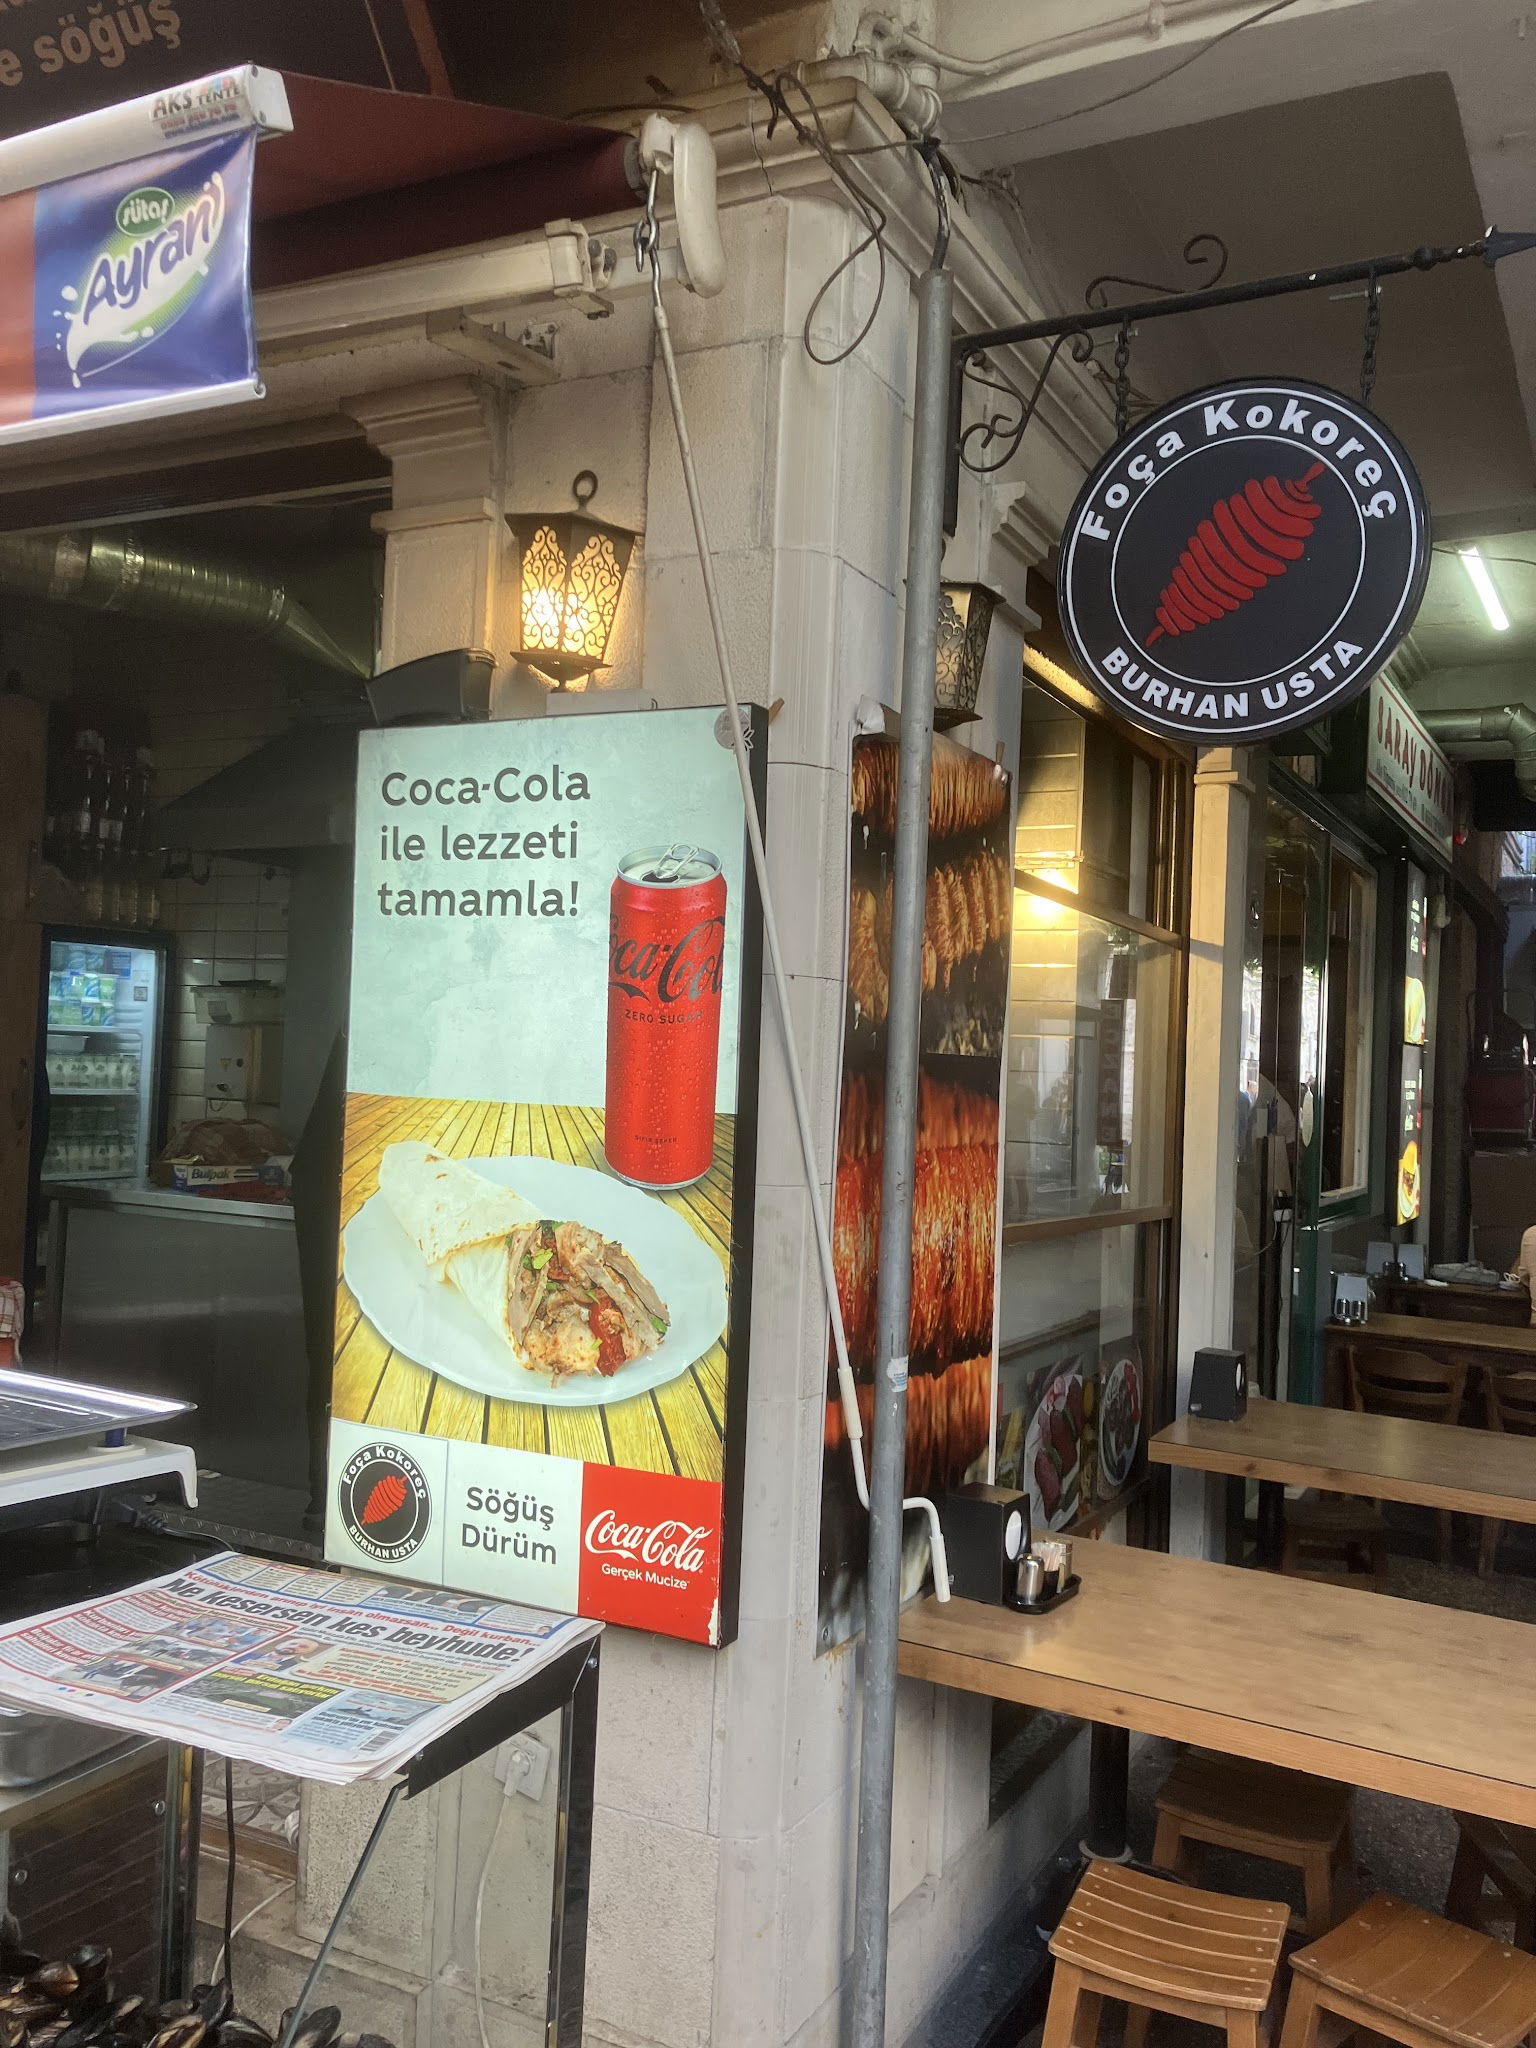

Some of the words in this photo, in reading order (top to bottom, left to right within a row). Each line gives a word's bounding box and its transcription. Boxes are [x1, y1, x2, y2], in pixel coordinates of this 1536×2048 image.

[153, 87, 192, 118] AKS
[197, 86, 241, 106] TENTE
[121, 197, 171, 227] sütaş
[83, 198, 210, 326] Ayran
[1080, 429, 1185, 541] Foça
[1203, 398, 1397, 519] Kokoreç
[1101, 646, 1249, 720] BURHAN
[1261, 639, 1364, 710] USTA
[381, 764, 591, 807] Coca-Cola
[380, 825, 426, 861] ile
[441, 820, 579, 861] lezzeti
[377, 880, 580, 917] tamamla!
[624, 1009, 654, 1023] ZERO
[659, 1010, 704, 1024] SUGAR
[342, 1451, 373, 1486] Foça
[375, 1445, 427, 1500] Kokoreç
[465, 1486, 555, 1532] Söğüş
[348, 1524, 390, 1560] BURHAN
[391, 1537, 418, 1559] USTA
[461, 1522, 558, 1566] Dürüm
[584, 1509, 714, 1573] Coca-Cola
[601, 1562, 643, 1582] Gerçek
[644, 1570, 689, 1590] Mucize
[157, 1577, 206, 1598] Ne
[198, 1590, 332, 1627] kesersen
[326, 1616, 388, 1638] kes
[383, 1626, 536, 1662] beyhude!
